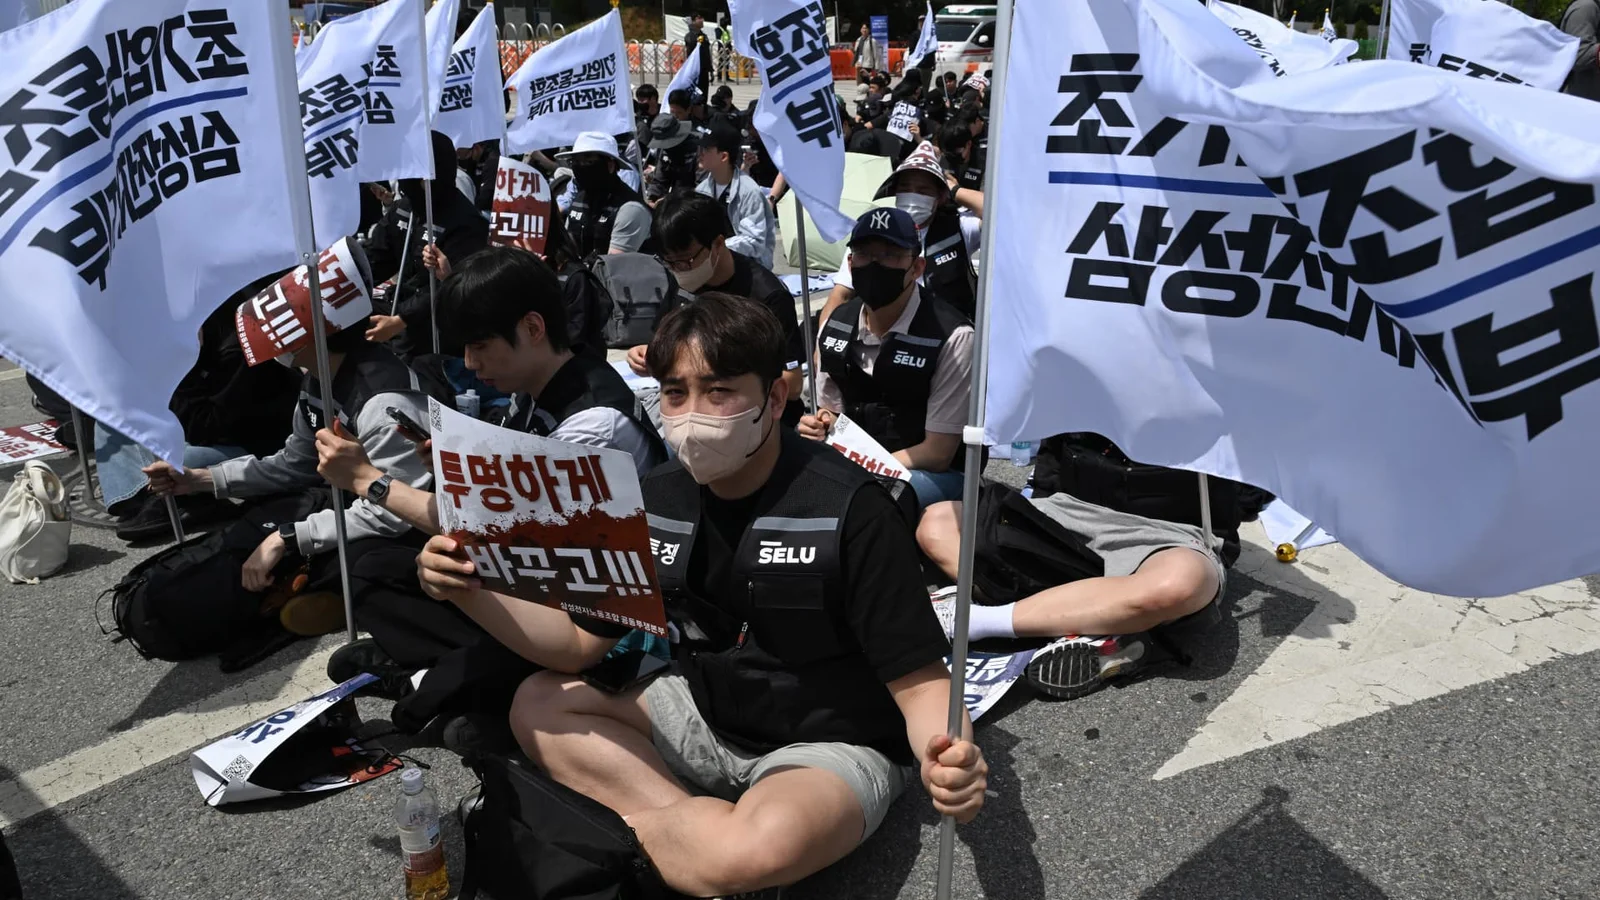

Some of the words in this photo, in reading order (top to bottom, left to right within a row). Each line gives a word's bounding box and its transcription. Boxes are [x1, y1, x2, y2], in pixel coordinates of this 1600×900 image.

[496, 167, 541, 196] 하게
[934, 251, 958, 266] SELU
[823, 336, 849, 352] 투쟁
[893, 350, 926, 368] SELU
[439, 449, 613, 513] 투명하게
[758, 540, 816, 564] SELU
